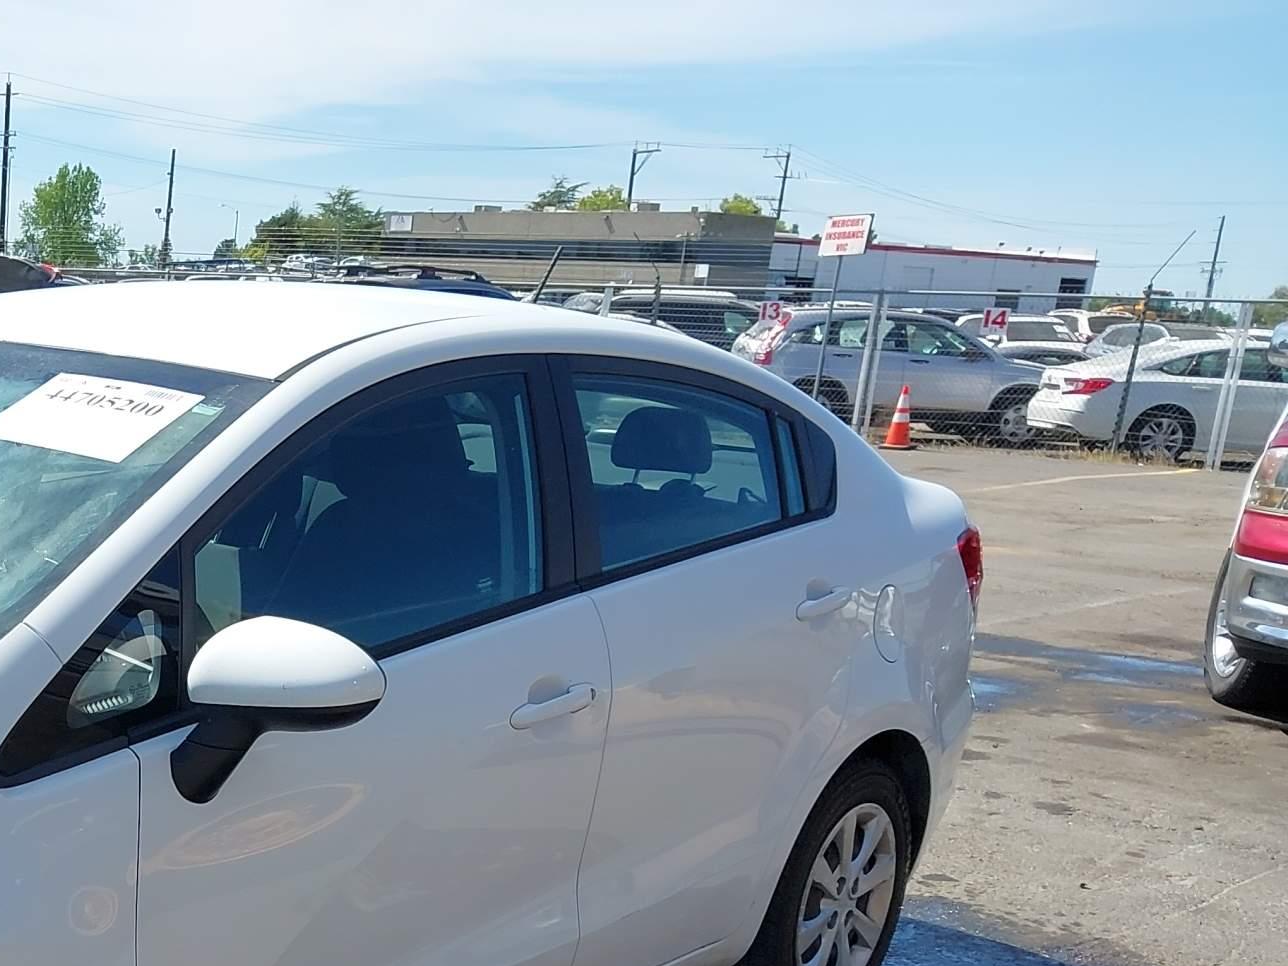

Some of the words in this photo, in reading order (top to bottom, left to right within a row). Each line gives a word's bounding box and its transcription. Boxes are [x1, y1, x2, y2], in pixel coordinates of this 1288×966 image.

[825, 230, 865, 240] INSURANCE
[761, 302, 780, 320] 13
[983, 310, 1007, 329] 14
[45, 388, 165, 416] 44705200
